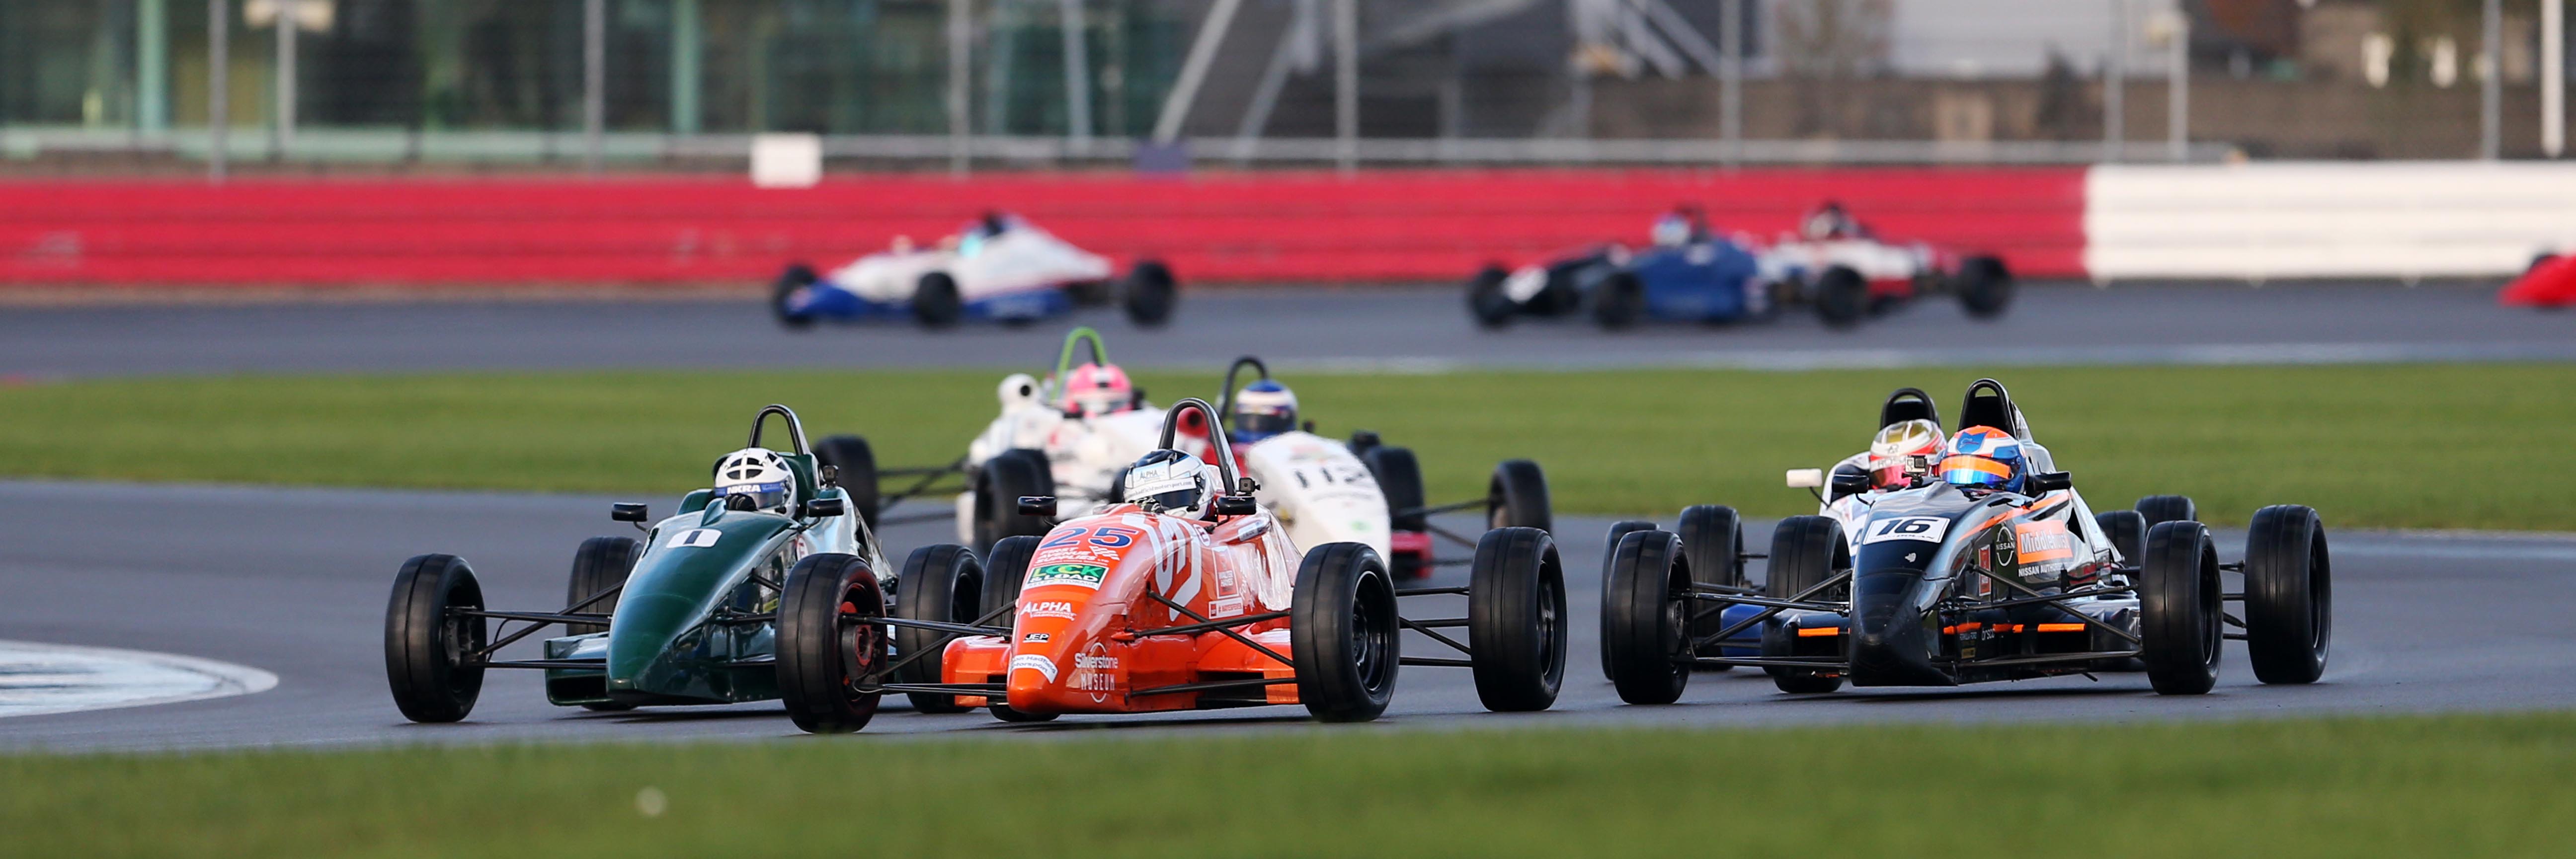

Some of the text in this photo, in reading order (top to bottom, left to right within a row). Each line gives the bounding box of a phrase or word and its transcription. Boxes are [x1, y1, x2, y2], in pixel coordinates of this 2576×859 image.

[1140, 469, 1158, 479] ALPHA
[726, 484, 761, 494] NKRA
[1876, 519, 1938, 536] 16
[683, 531, 703, 545] 1
[1039, 526, 1138, 549] 25
[1044, 573, 1099, 582] LOAD
[2018, 564, 2040, 577] NISSAN
[1020, 601, 1071, 616] ALPHA
[1074, 653, 1118, 669] Silverstone
[1081, 673, 1115, 691] MUSEUM
